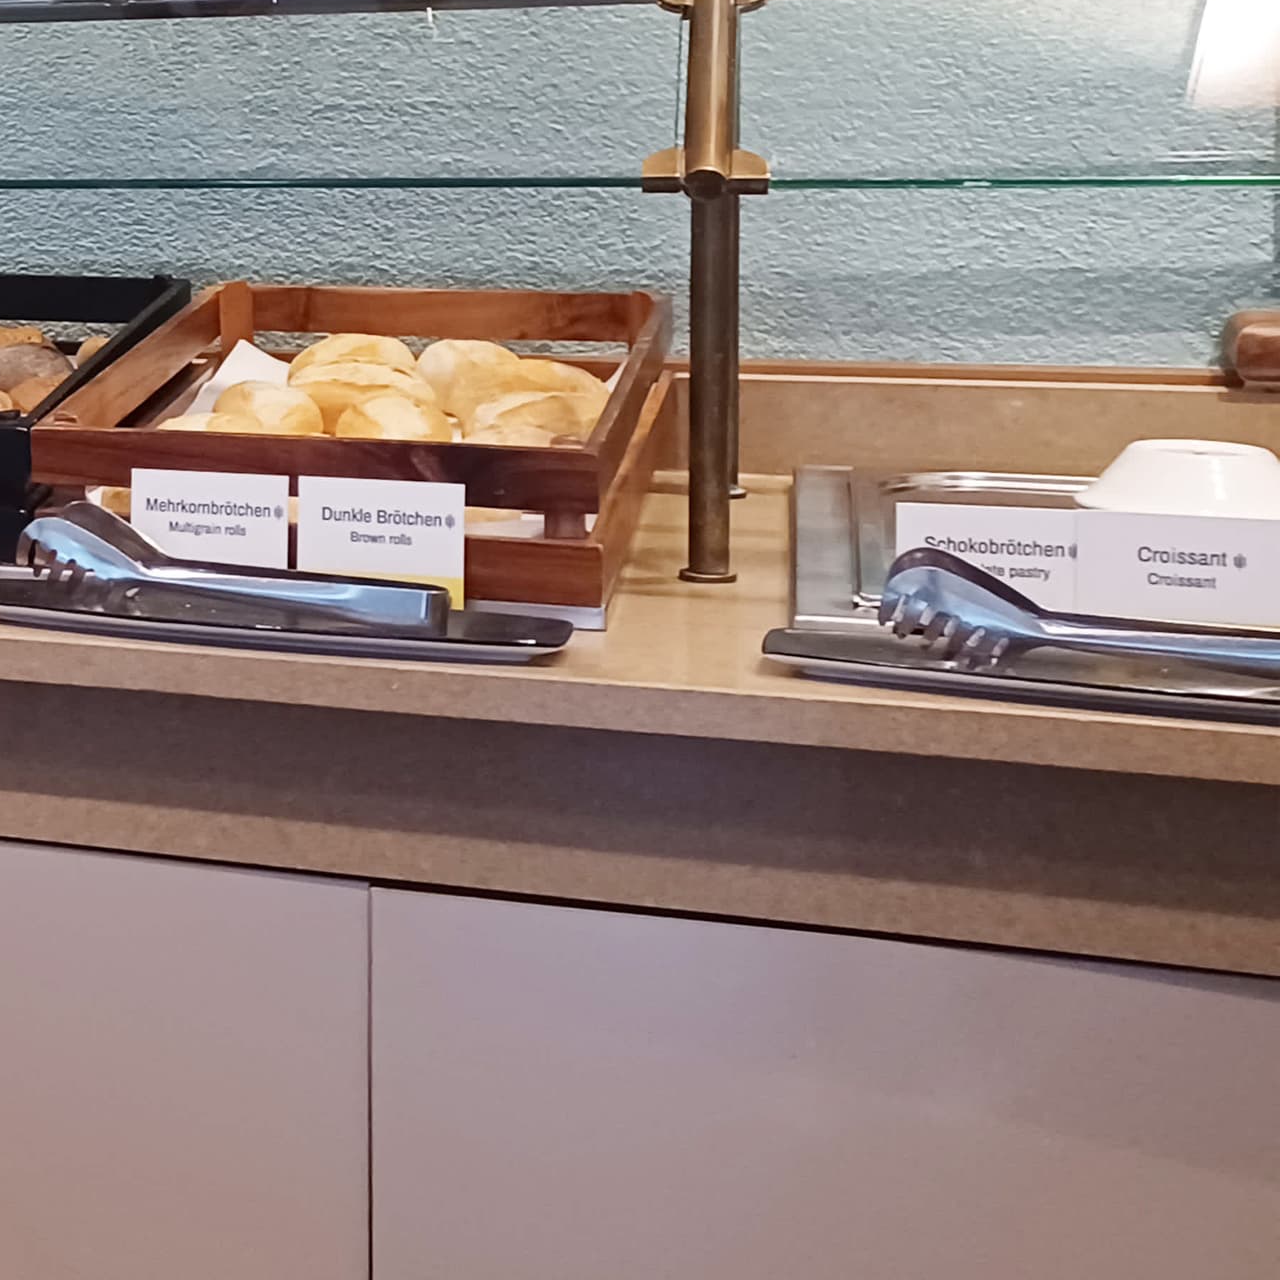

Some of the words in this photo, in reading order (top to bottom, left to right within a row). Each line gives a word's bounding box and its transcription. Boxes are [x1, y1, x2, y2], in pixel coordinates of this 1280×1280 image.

[321, 506, 373, 524] Dunkle
[376, 509, 443, 527] Brötchen
[168, 521, 223, 536] Multigrain
[224, 523, 247, 536] rolls
[349, 531, 386, 544] Brown
[388, 533, 413, 546] rolls
[924, 535, 1066, 558] Schokobrötchen
[1137, 545, 1228, 568] Croissant
[1146, 572, 1218, 590] Croissant
